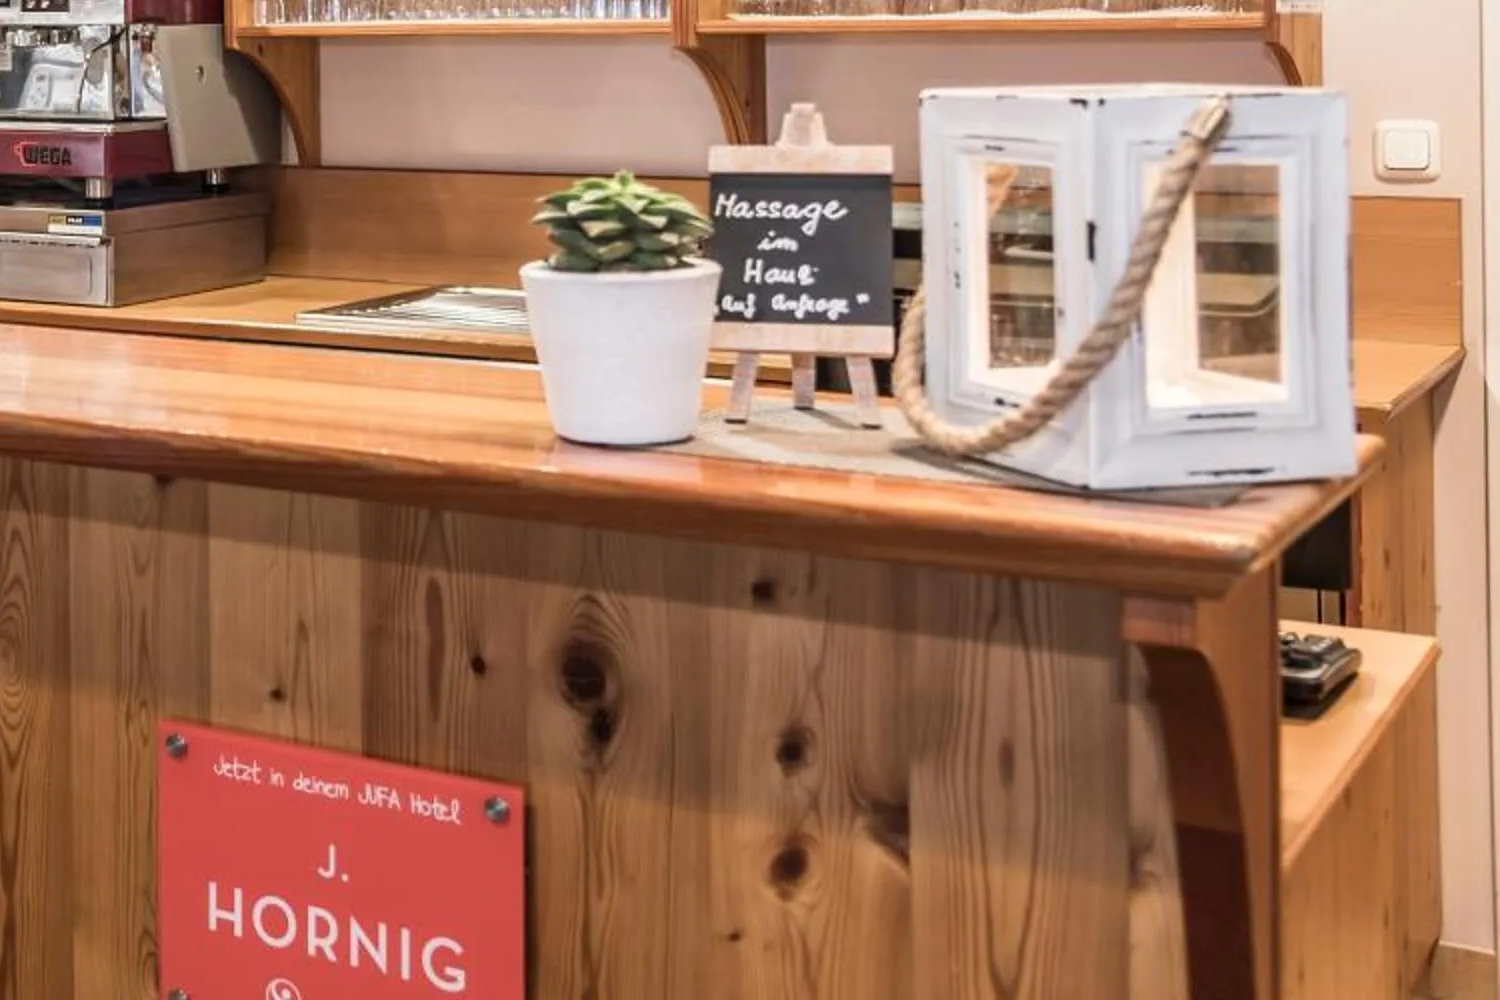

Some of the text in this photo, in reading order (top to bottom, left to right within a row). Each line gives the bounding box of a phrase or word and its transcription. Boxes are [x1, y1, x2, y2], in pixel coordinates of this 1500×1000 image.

[23, 144, 73, 166] WEGA
[714, 193, 848, 235] Massage
[757, 230, 799, 252] im
[213, 754, 462, 825] Jetzt in deinem JUFA Hotel
[317, 843, 349, 883] J.
[207, 880, 466, 993] HORNIG
